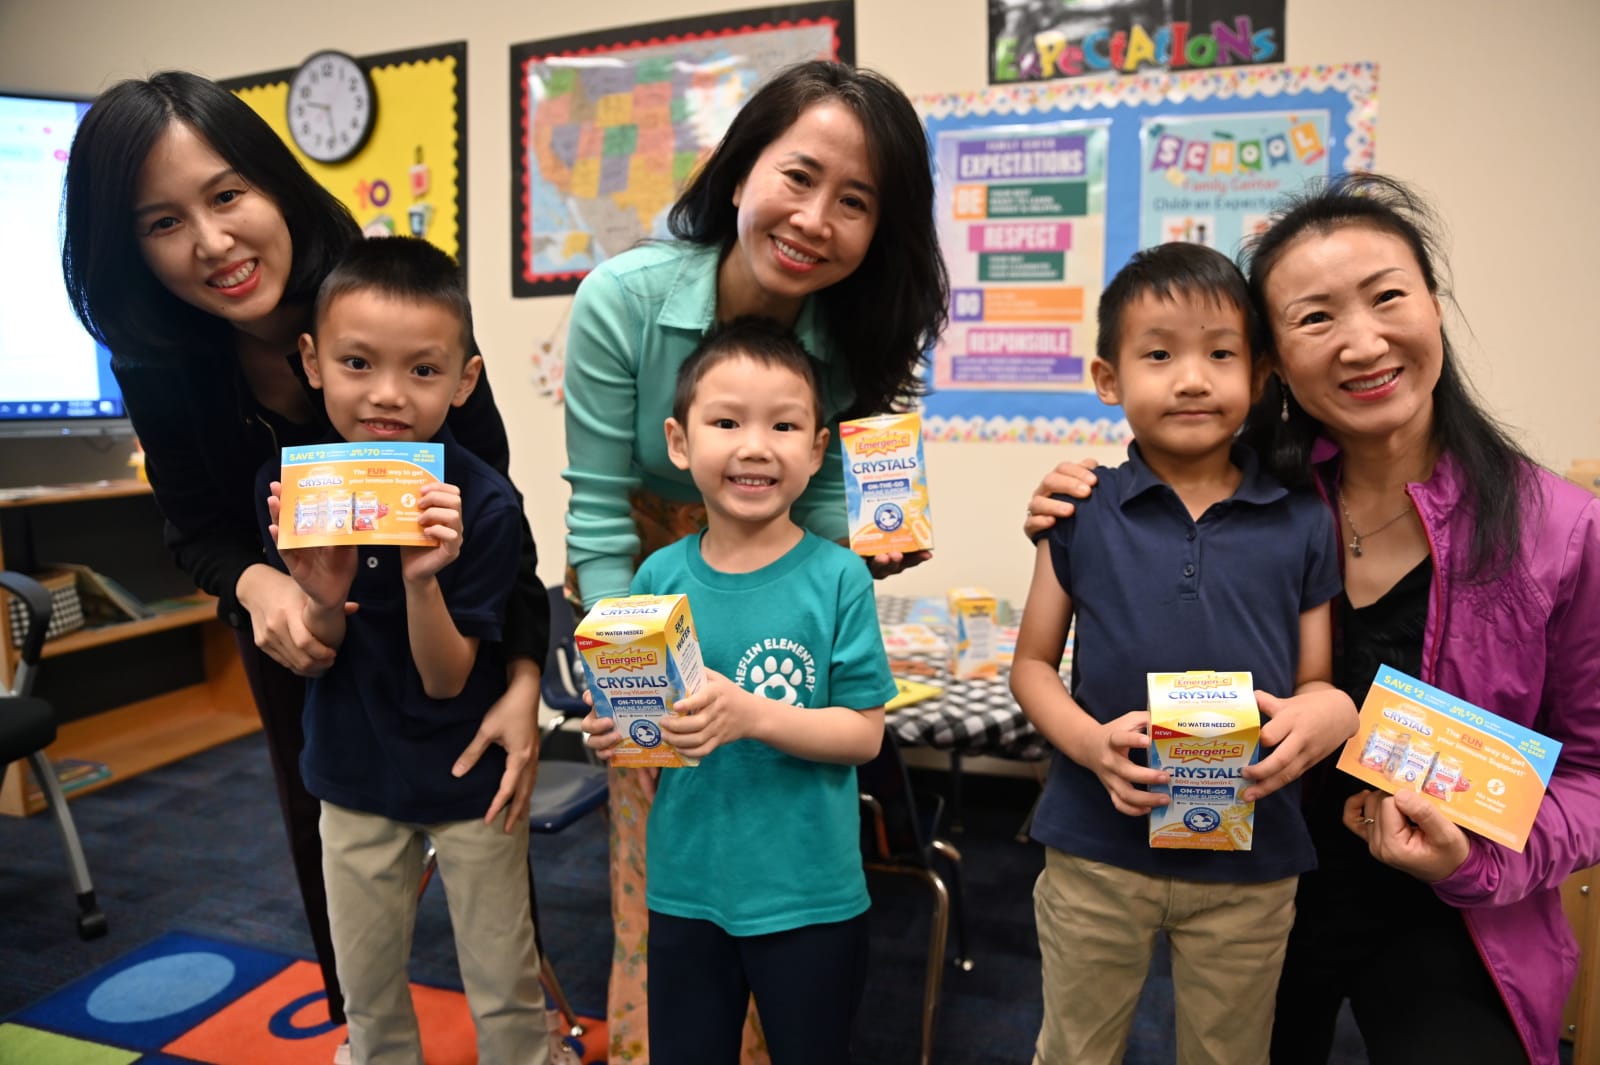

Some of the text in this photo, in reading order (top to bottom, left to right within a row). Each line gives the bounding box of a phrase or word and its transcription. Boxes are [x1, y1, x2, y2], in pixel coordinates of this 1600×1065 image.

[1157, 128, 1315, 164] SCHOOL
[960, 150, 1083, 178] EXPECTATIONS
[984, 225, 1058, 249] RESPECT
[969, 331, 1067, 354] RESPONSIBLE
[860, 438, 906, 450] Emergen-C
[289, 452, 314, 461] SAVE
[852, 457, 917, 475] CRYSTALS
[298, 477, 342, 488] CRYSTALS
[601, 607, 660, 616] CRYSTALS
[676, 625, 691, 651] WATER
[600, 653, 654, 665] Emergen-C
[735, 642, 763, 686] HEFLIN
[764, 638, 816, 692] ELEMENTARY
[596, 675, 668, 689] CRYSTALS
[1178, 678, 1229, 686] Emergen-C
[1384, 675, 1425, 699] SAVE $2
[1168, 690, 1238, 699] CRYSTALS
[1383, 709, 1432, 736] CRYSTALS
[1460, 734, 1483, 748] FUN
[1174, 746, 1240, 757] Emergen-C
